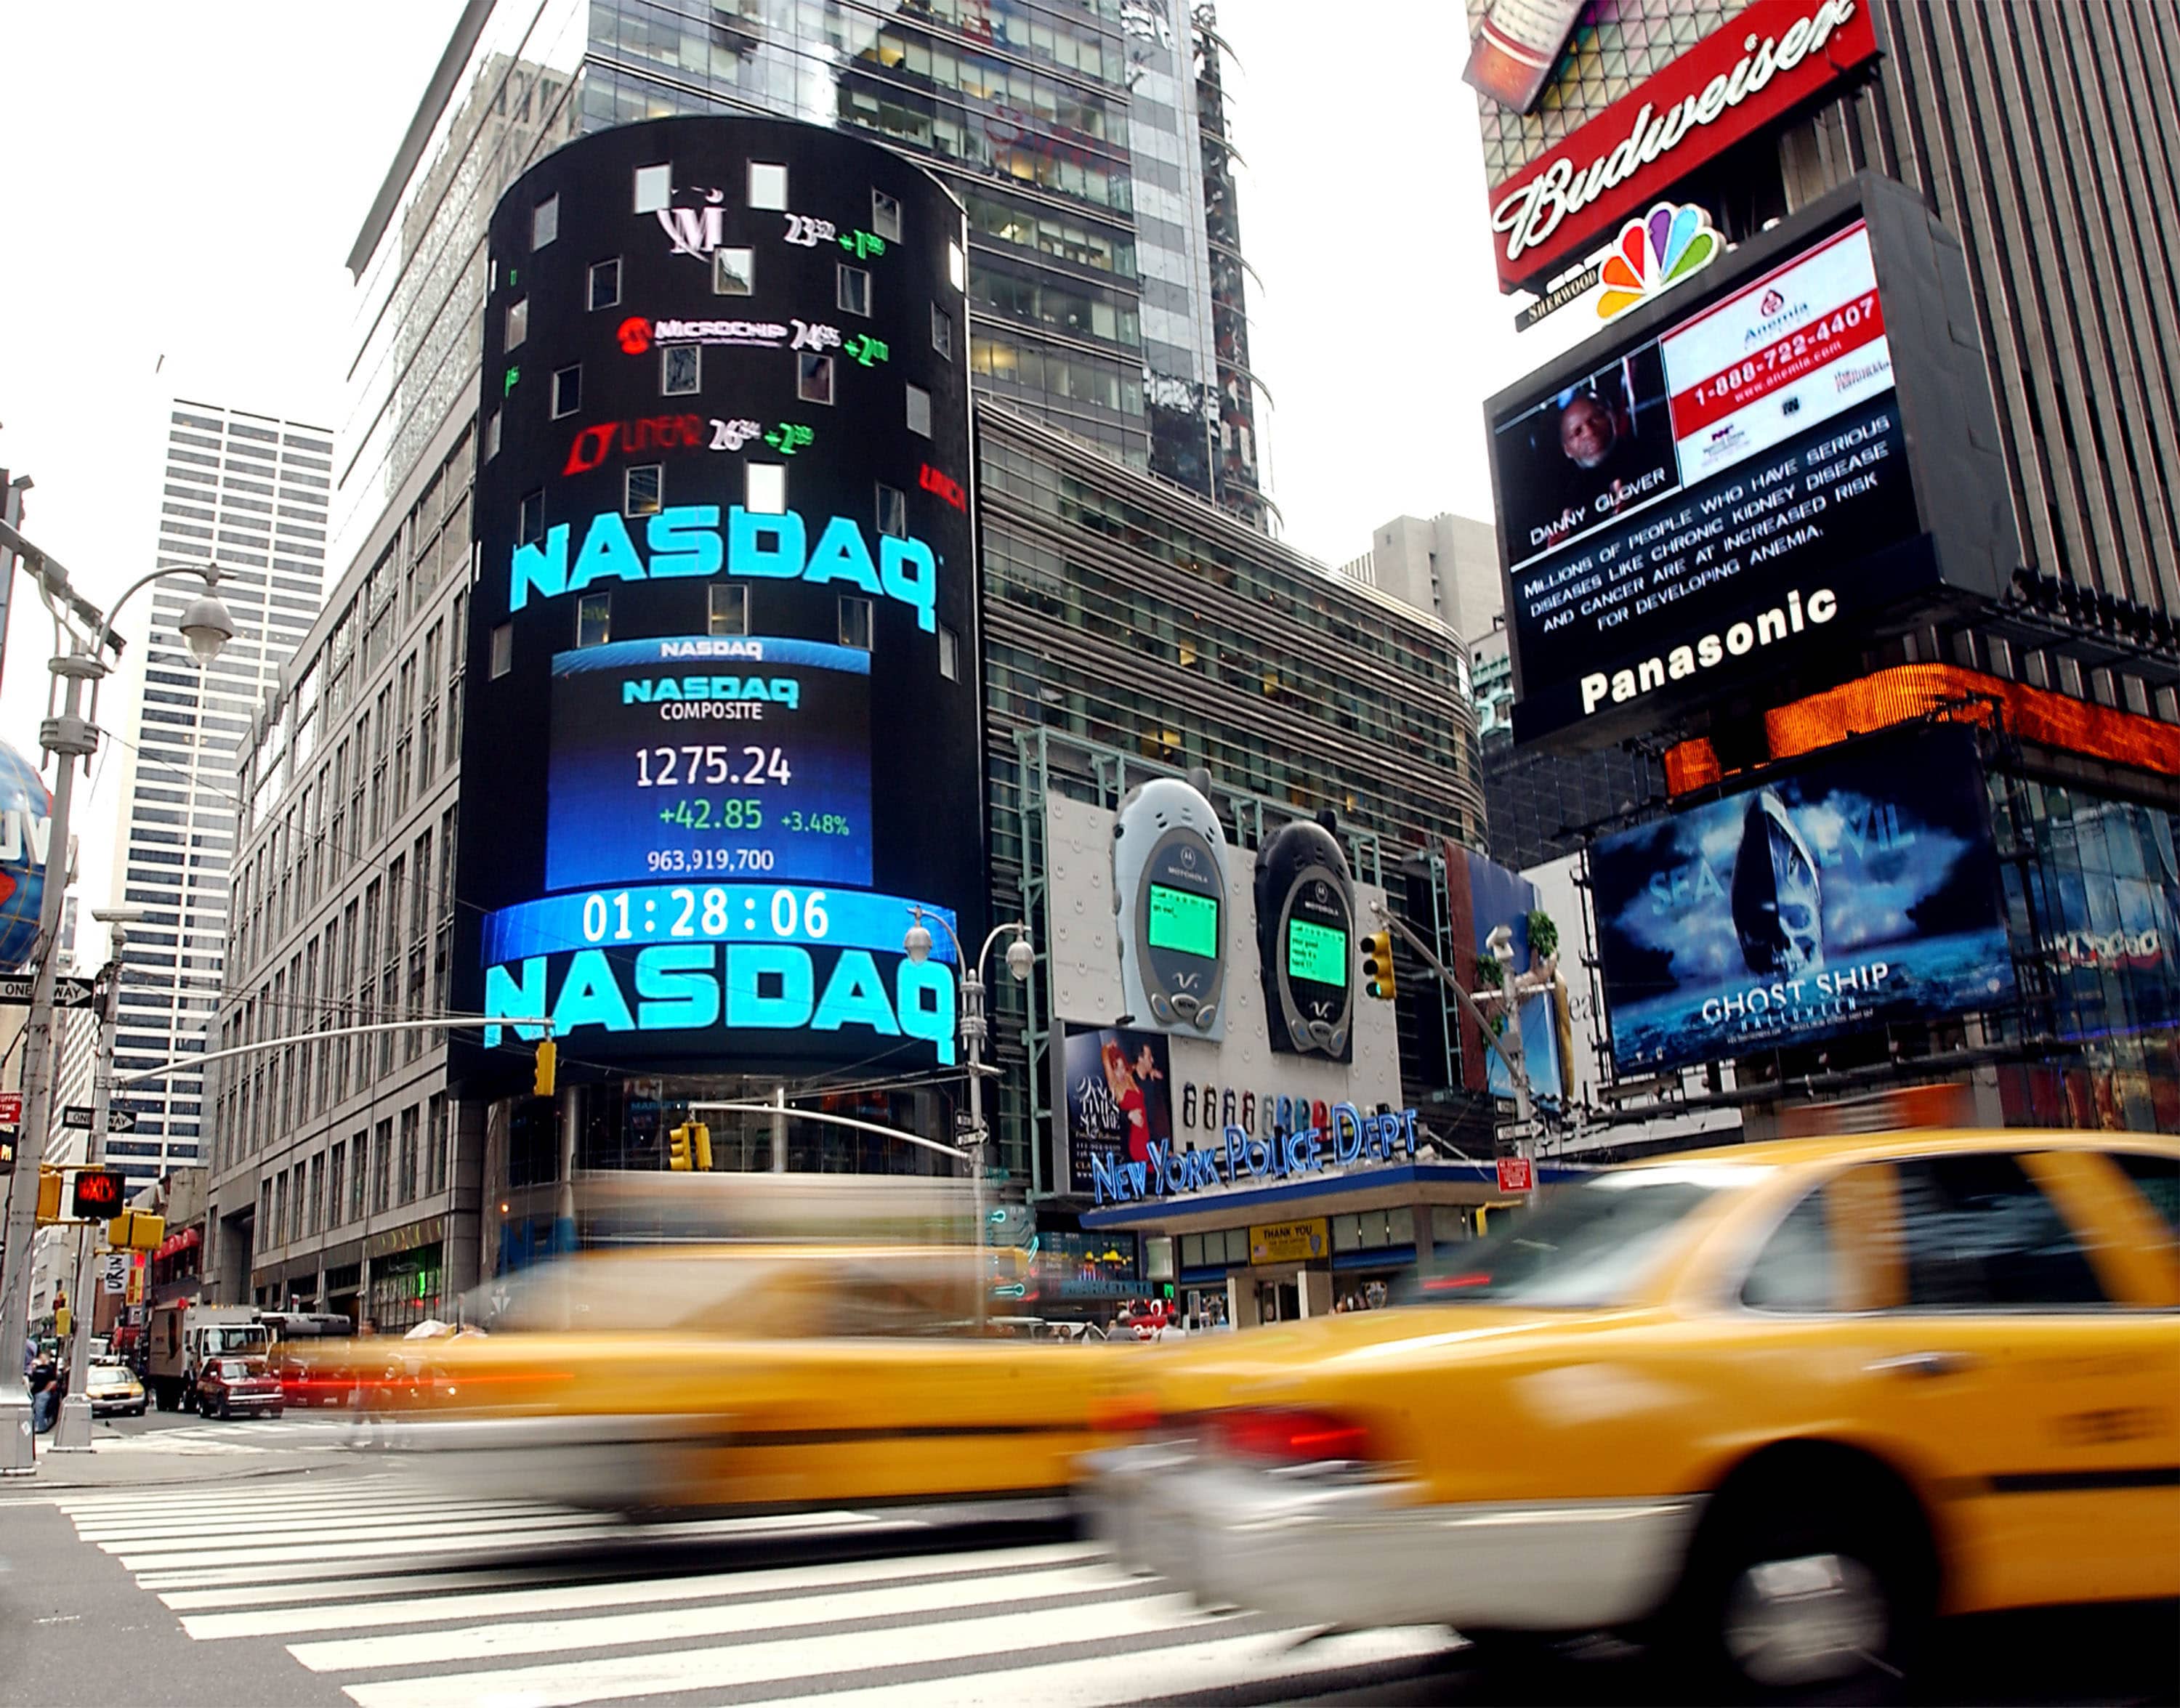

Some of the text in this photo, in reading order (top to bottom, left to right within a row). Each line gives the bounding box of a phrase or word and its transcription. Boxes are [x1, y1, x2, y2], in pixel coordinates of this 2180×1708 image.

[1493, 0, 1857, 262] Budweiser
[1528, 269, 1597, 323] SHERWOOD
[1695, 296, 1875, 407] 1-888-722-4407
[1734, 340, 1843, 403] www.anemia.com
[1523, 414, 1891, 599] MILLIONS OF PEOPLE WHO HAVE SERIOUS
[1530, 466, 1666, 546] DANNY GLOVER
[1530, 573, 1603, 618] DISEASES
[1608, 554, 1645, 582] LIKE
[1650, 517, 1725, 562] CHRONIC
[1732, 482, 1796, 525] KIDNEY
[1806, 440, 1890, 492] DISEASE
[510, 504, 937, 634] NASDAQ
[1543, 470, 1878, 634] AND CANCER ARE AT INCREASED RISK
[1597, 524, 1824, 632] FOR DEVELOPING ANEMIA.
[661, 640, 763, 661] NASDAQ
[1580, 588, 1838, 715] Panasonic
[623, 676, 799, 709] NASDAQ
[660, 702, 764, 721] COMPOSITE
[635, 746, 792, 787] 1275.24
[660, 799, 850, 835] +42.85 +3.48%
[647, 849, 775, 872] 963,919,700
[1167, 865, 1208, 884] MOTOROLA
[1648, 802, 1916, 915] SEA EVIL
[1304, 900, 1339, 917] MOTOROLA
[5, 983, 81, 999] ONE WAY
[483, 944, 956, 1067] NASDAQ
[1702, 961, 1889, 1026] GHOST SHIP
[1740, 995, 1857, 1034] HALLOWEEN
[73, 1113, 91, 1124] ON
[1090, 1101, 1418, 1205] NEW YORK POLICE DEPT
[1263, 1223, 1313, 1239] THANK YOU
